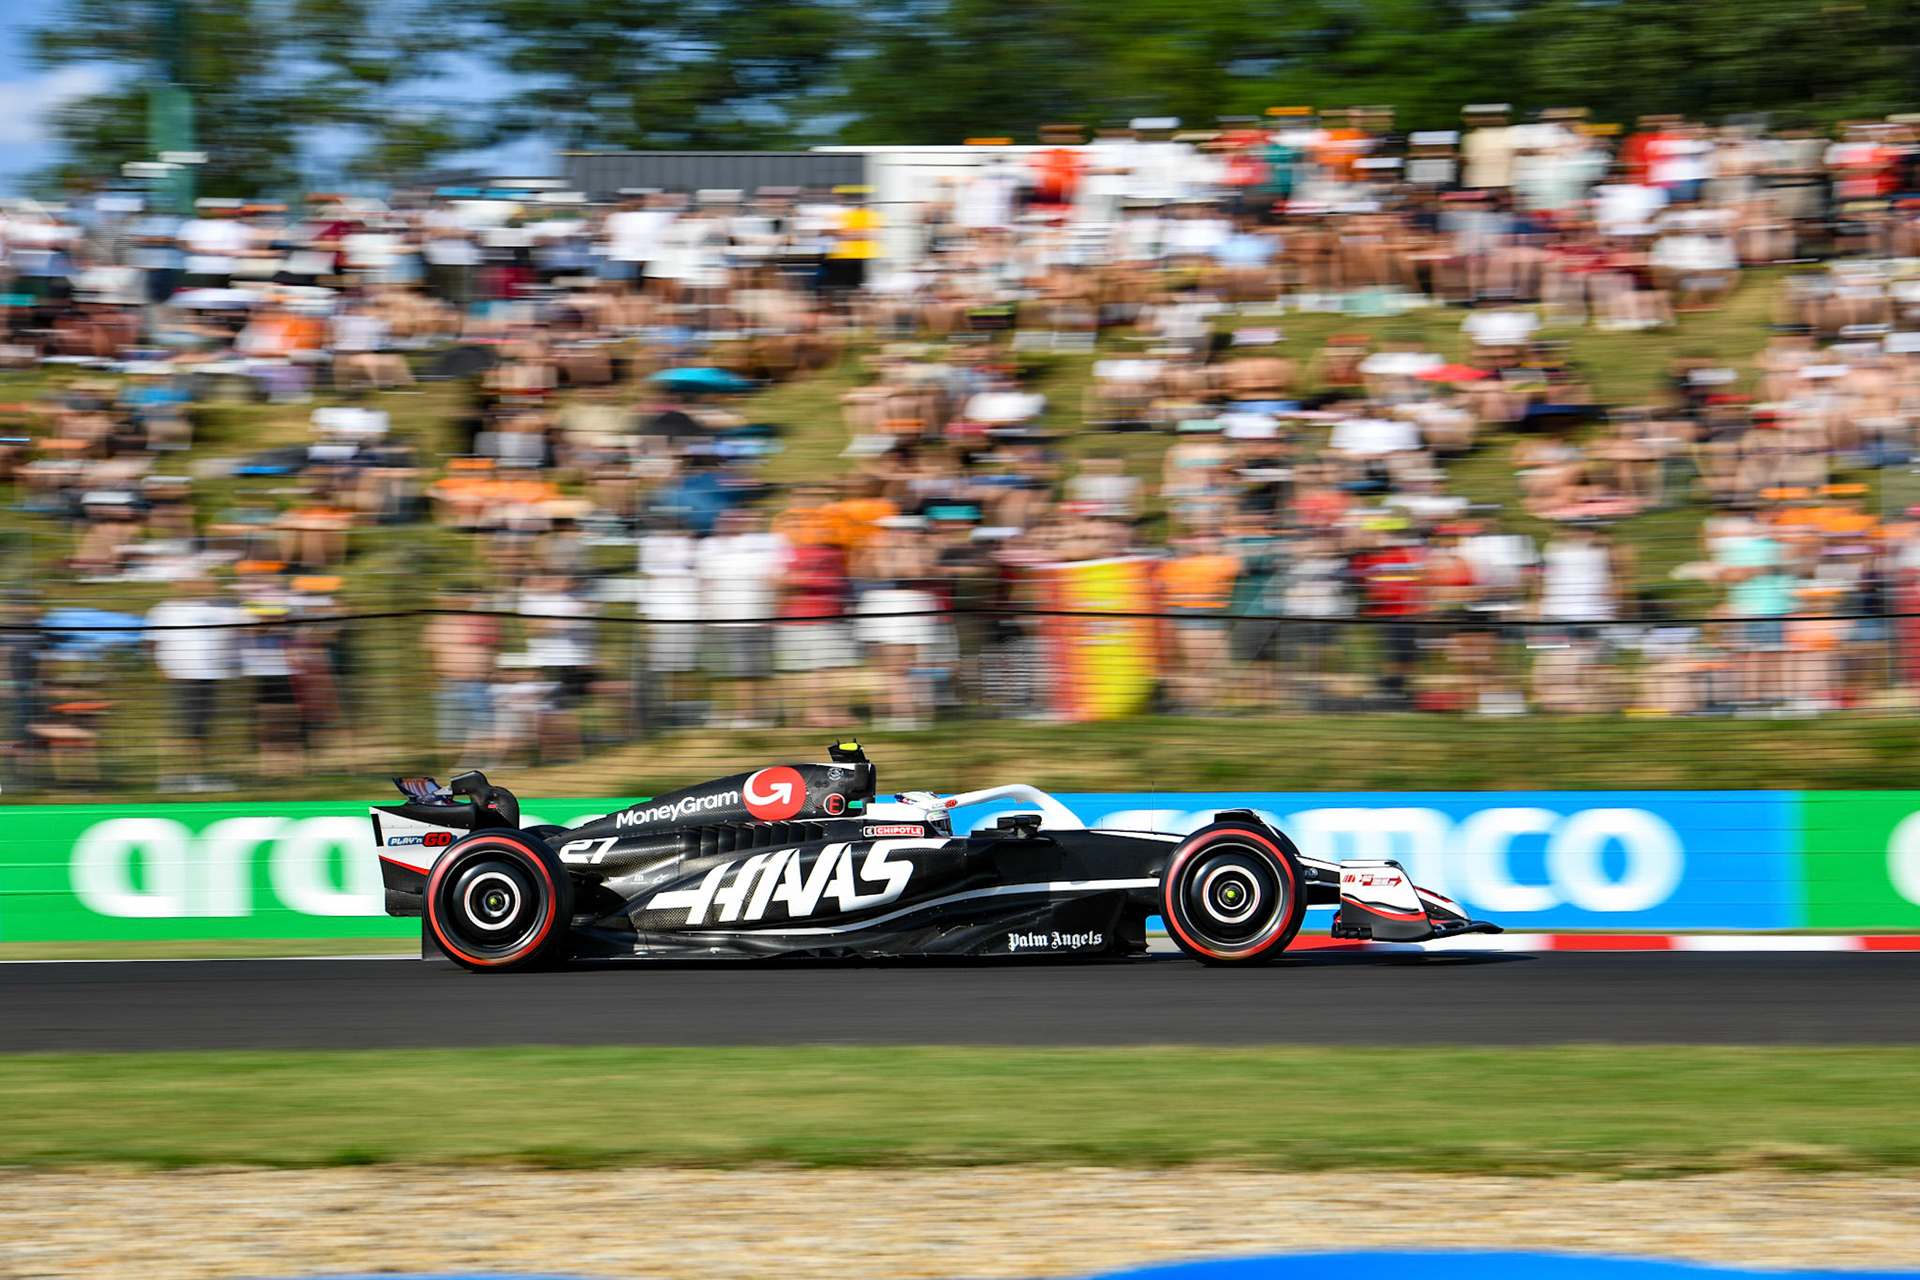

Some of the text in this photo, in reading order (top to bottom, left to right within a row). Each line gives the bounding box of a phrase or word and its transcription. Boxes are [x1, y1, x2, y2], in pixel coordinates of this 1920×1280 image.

[616, 791, 738, 828] MoneyGram
[828, 795, 841, 813] E
[423, 832, 452, 847] GO
[877, 827, 921, 835] CHIPOTLE
[559, 837, 619, 864] 27
[646, 838, 951, 925] HAAS
[1008, 930, 1102, 951] Palm Angels
